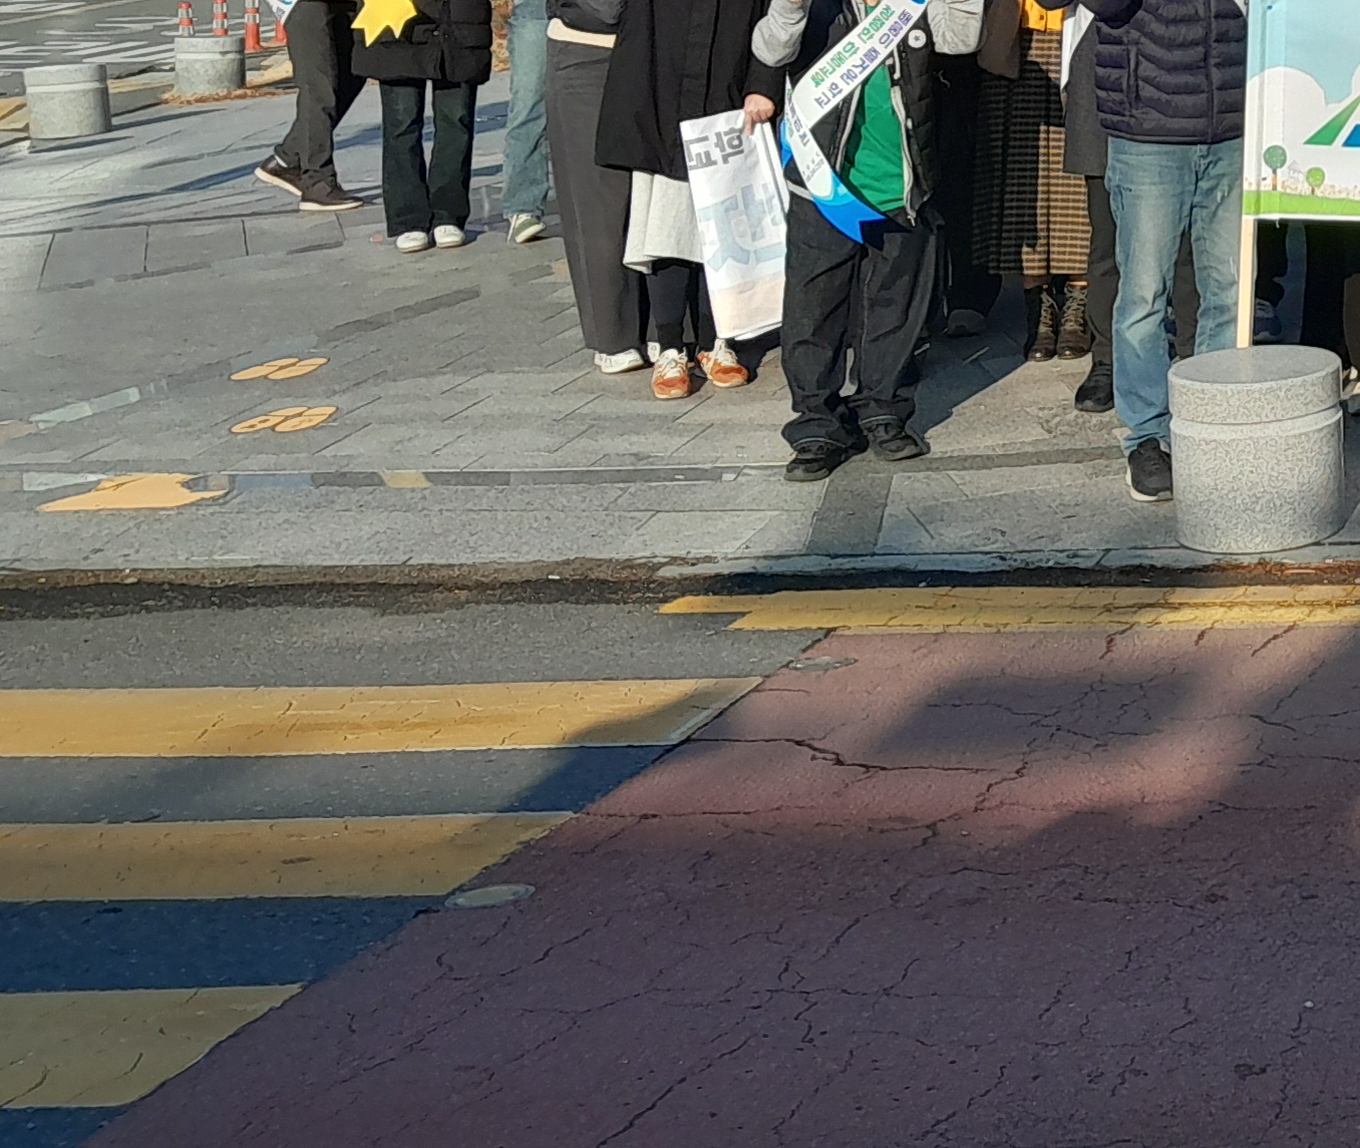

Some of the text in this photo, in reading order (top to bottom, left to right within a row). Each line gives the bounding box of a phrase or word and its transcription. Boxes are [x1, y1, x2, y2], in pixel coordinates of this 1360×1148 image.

[813, 8, 912, 109] 배움이 즐거운 학교
